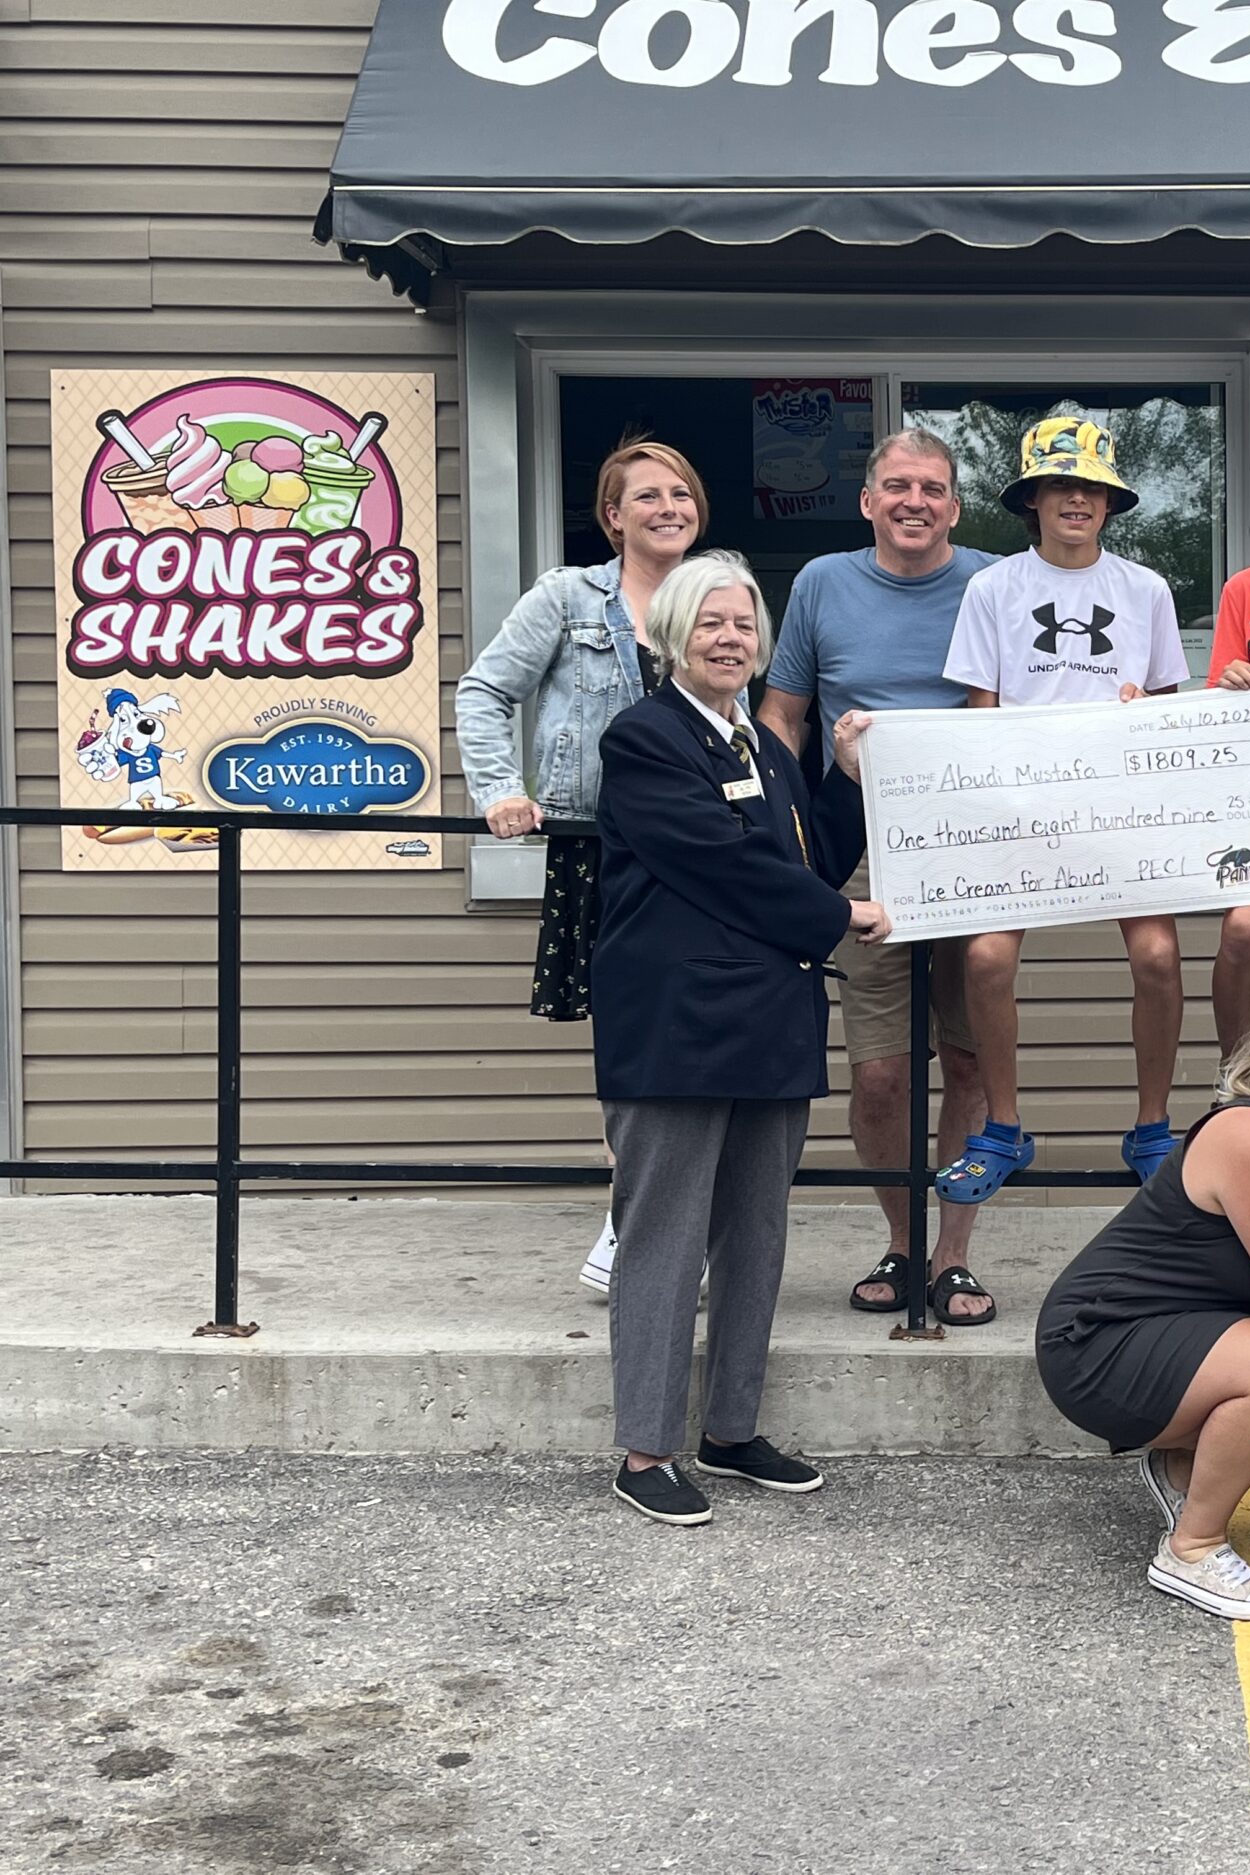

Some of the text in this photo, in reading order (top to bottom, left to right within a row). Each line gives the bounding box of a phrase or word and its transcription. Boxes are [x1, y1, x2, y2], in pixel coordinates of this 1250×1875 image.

[441, 0, 1122, 87] Cones
[81, 535, 411, 596] CONES &
[74, 601, 416, 662] SHAKES
[1028, 660, 1118, 676] UNDER ARMOUR
[253, 697, 378, 728] PROUDLY SERVING
[1159, 713, 1193, 733] July
[1128, 723, 1155, 733] DATE
[279, 732, 354, 753] EST. 1937
[135, 757, 154, 773] S
[1128, 746, 1238, 772] $1809.25
[225, 754, 409, 794] Kawartha
[880, 772, 936, 788] PAY TO THE
[939, 757, 1101, 791] Abudi Mustafa
[880, 784, 932, 798] ORDER OF
[282, 795, 351, 814] DAIRY
[1227, 795, 1245, 809] 25
[887, 804, 1218, 850] One thousand eight hundred nine
[920, 866, 1109, 904] Ice Cream for Abudi
[893, 896, 915, 906] FOR
